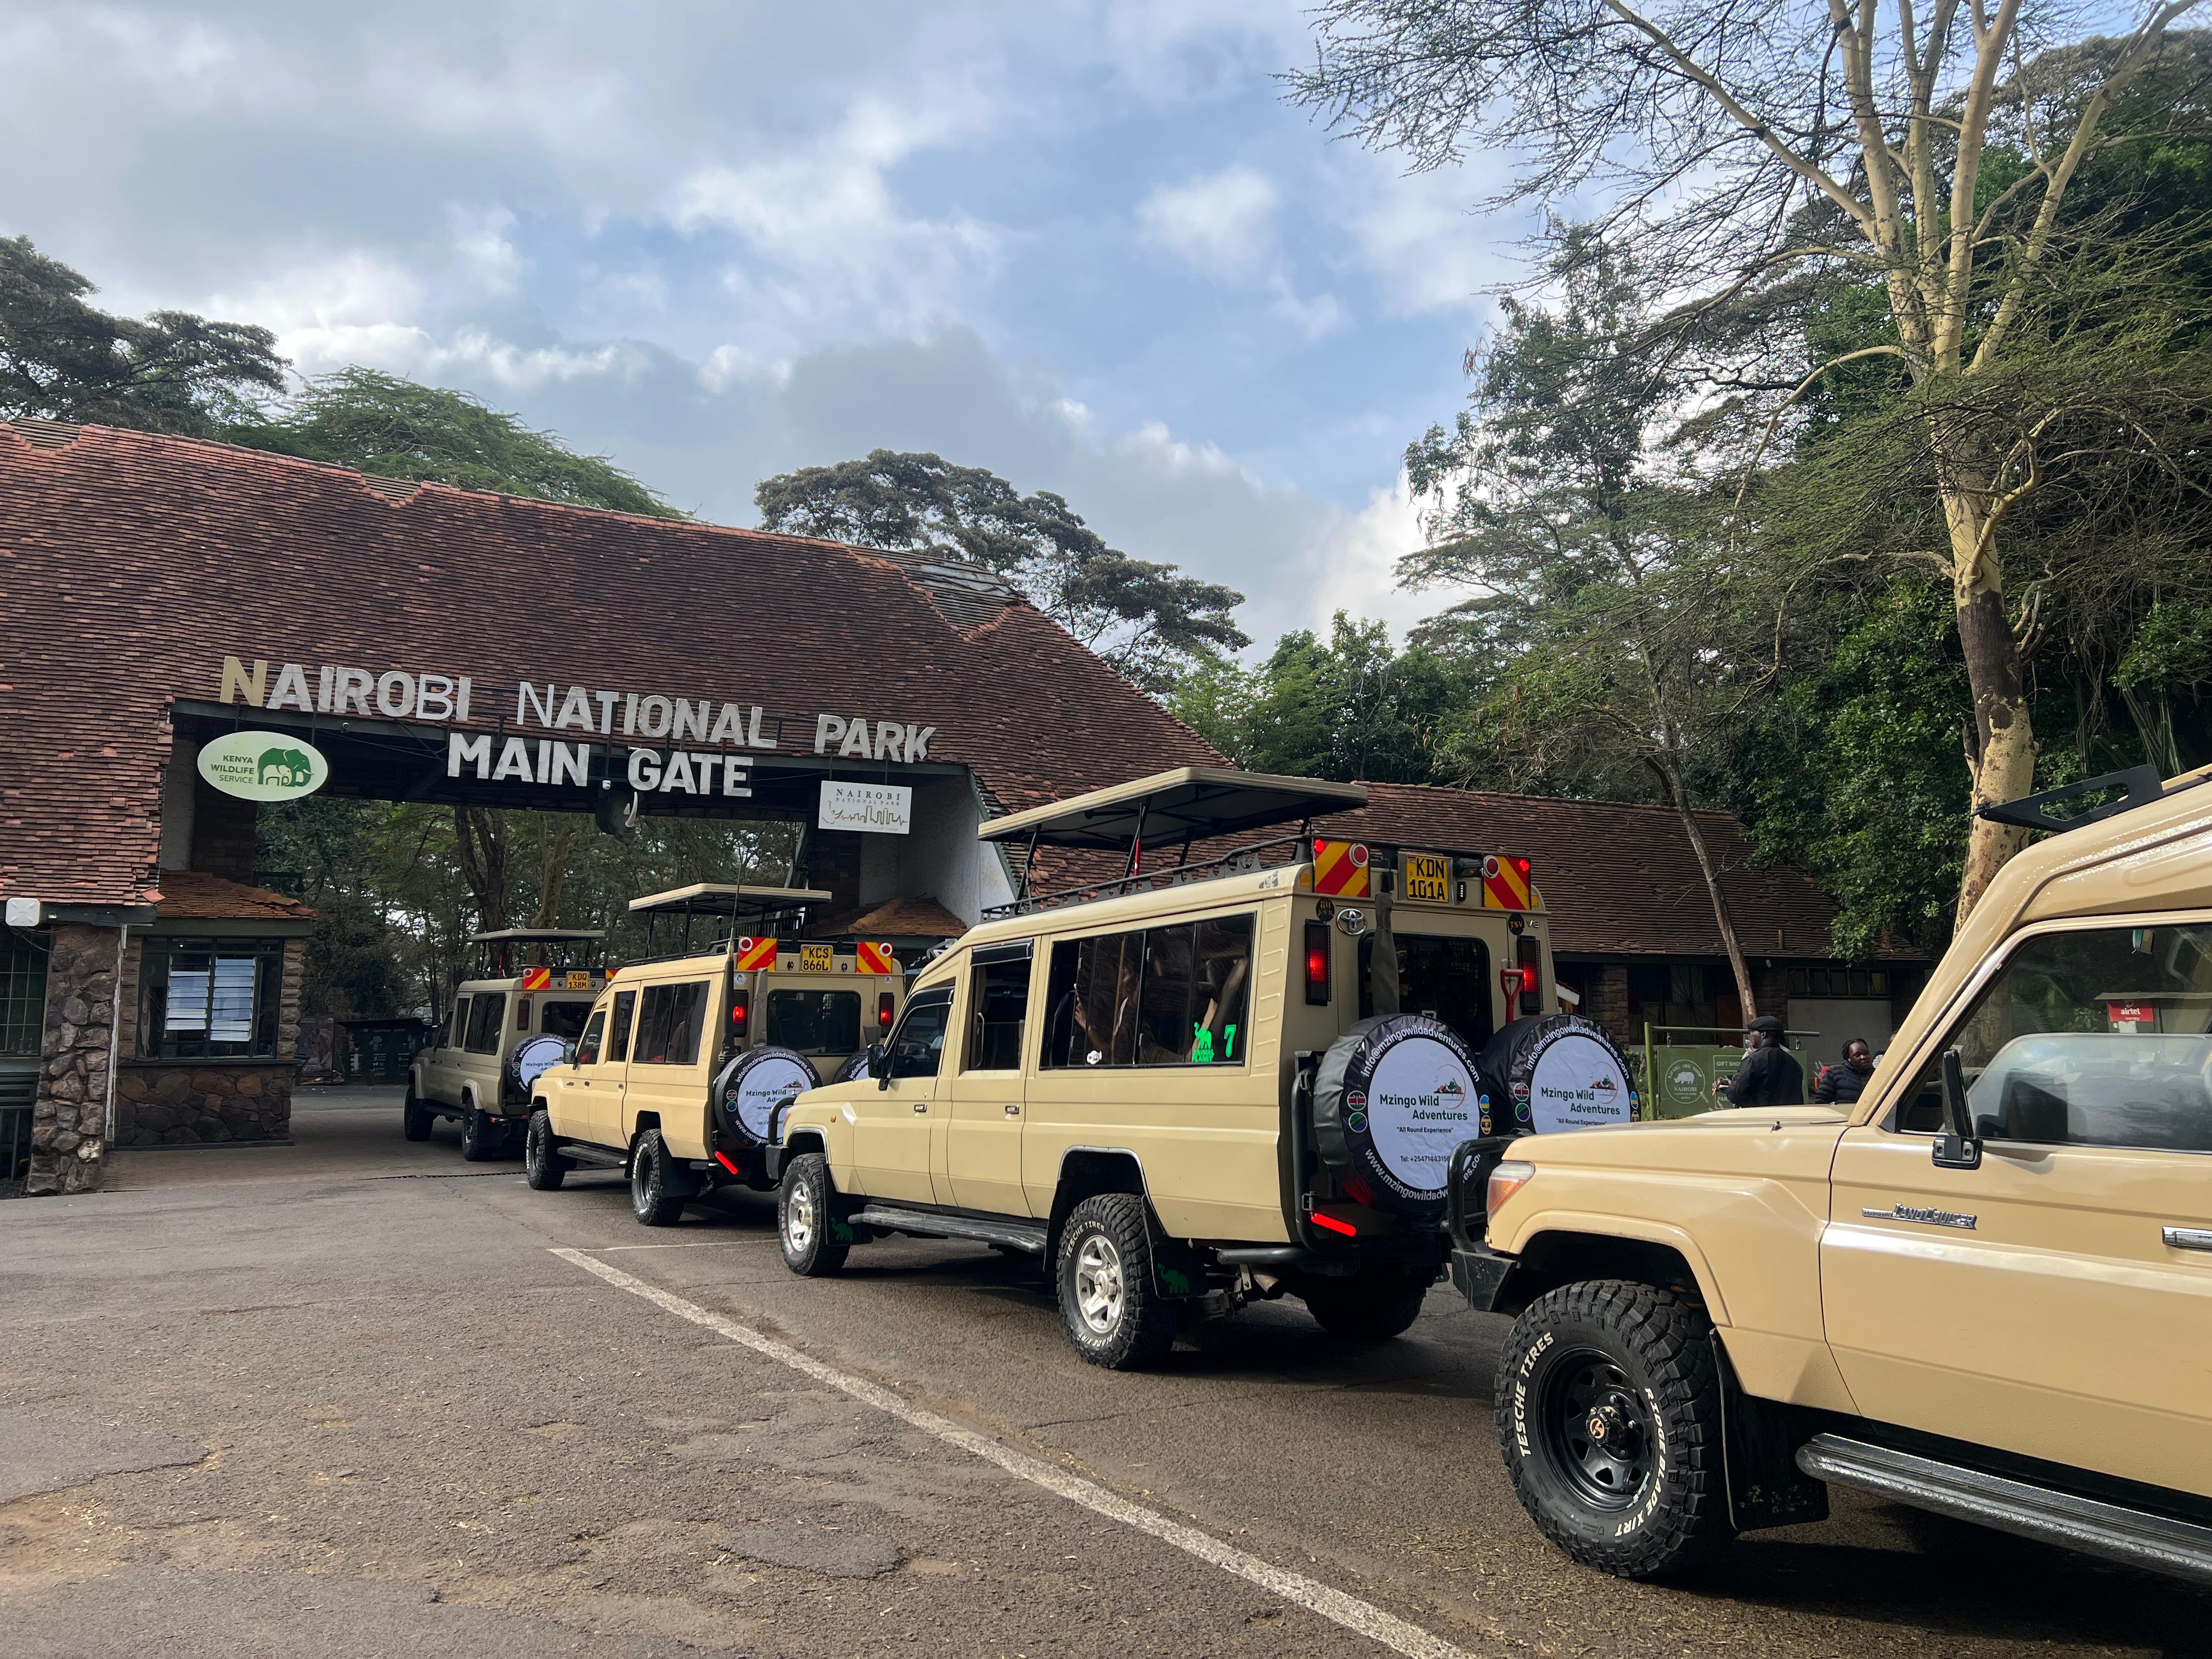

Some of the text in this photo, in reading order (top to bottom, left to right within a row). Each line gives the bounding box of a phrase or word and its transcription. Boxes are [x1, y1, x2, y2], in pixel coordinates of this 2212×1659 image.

[219, 656, 937, 763] NAIROBI NATIONAL PARK
[211, 764, 255, 774] WILDLIFE
[222, 754, 253, 764] KENYA
[447, 732, 754, 797] MAIN GATE
[219, 774, 253, 783] SERVICE
[836, 788, 901, 800] NAIROBI
[1416, 857, 1445, 879] KDN
[1408, 879, 1446, 900] 101A
[809, 947, 829, 958] KCS
[803, 960, 829, 971] 866L
[568, 981, 587, 989] 138M
[1224, 1024, 1236, 1058] 7
[1524, 1024, 1629, 1079] info@mzingowildadventures.com
[1361, 1025, 1480, 1083] info@mzingowildadventures.com
[735, 1051, 815, 1083] info@mzingowildadventures.com
[1380, 1094, 1439, 1108] Mzingo Wild
[1541, 1087, 1594, 1102] Mzingo Wild
[1412, 1110, 1468, 1120] Adventures
[1570, 1103, 1620, 1115] Adventures
[1066, 1221, 1105, 1258] TESCHE TIRES
[1514, 1331, 1555, 1457] TESCHE TIRES
[1645, 1388, 1666, 1454] RIDGE
[1646, 1455, 1666, 1516] BLADE
